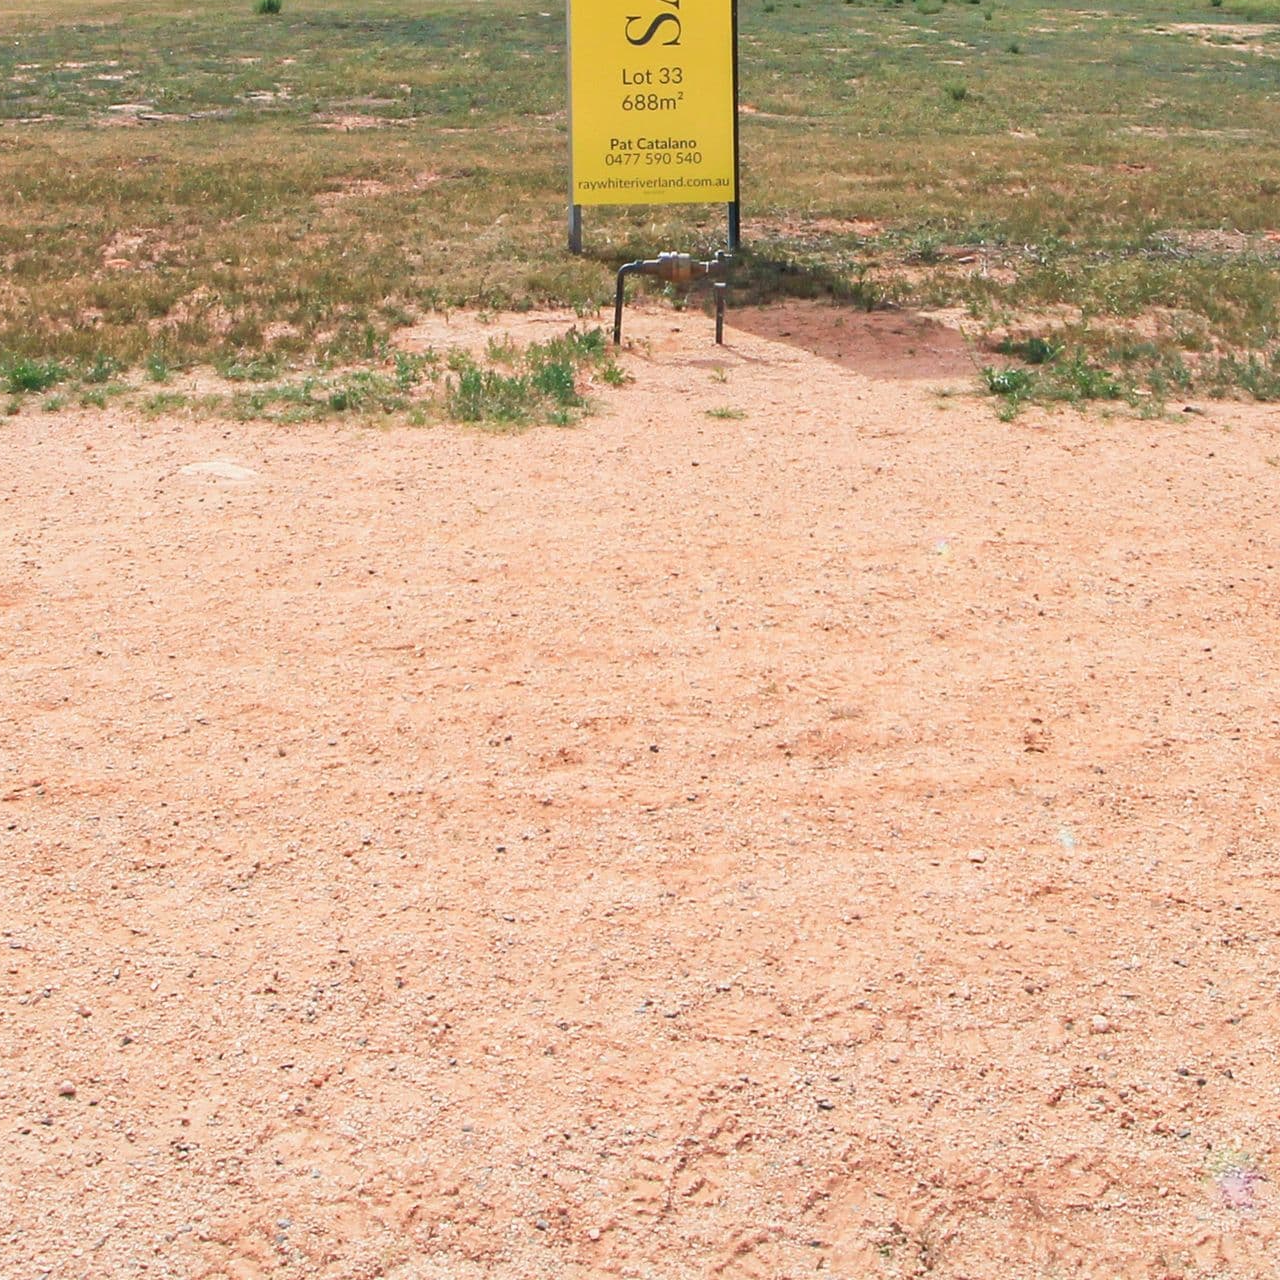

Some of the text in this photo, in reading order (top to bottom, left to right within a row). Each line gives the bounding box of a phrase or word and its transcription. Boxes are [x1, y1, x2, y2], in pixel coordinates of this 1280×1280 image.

[622, 67, 683, 85] Lot 33
[610, 137, 697, 150] Pat Catalano
[605, 152, 702, 166] 0477 590 540
[578, 176, 730, 191] raywhiteriverland.com.au
